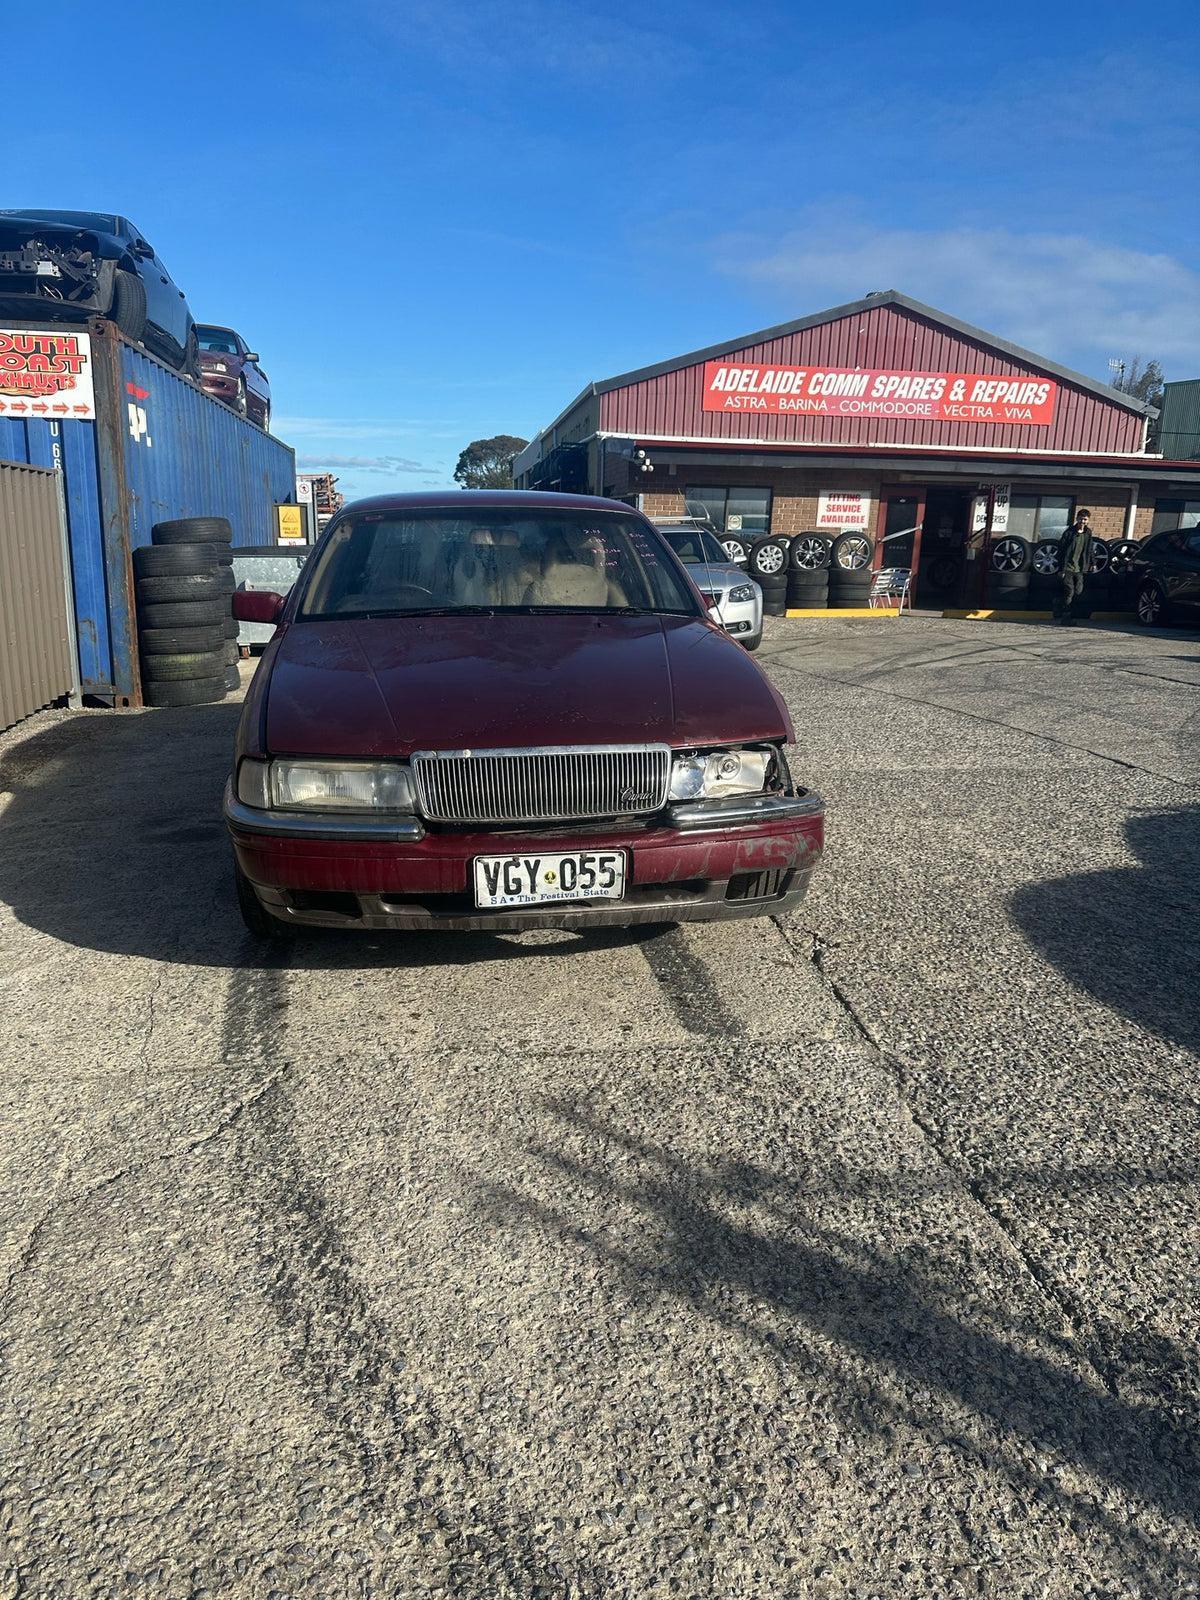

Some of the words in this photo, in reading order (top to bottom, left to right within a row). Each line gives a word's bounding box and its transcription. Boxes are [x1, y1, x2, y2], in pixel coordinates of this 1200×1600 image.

[710, 368, 806, 394] ADELAIDE
[808, 373, 870, 397] COMM
[871, 375, 947, 400] SPARES
[949, 379, 967, 402] &
[970, 380, 1050, 406] REPAIRS
[724, 396, 767, 409] ASTRA
[779, 398, 828, 411] BARINA
[839, 400, 932, 415] COMMODORE
[943, 405, 994, 418] VECTRA
[1004, 407, 1032, 420] VIVA
[829, 493, 861, 502] FITTING
[826, 504, 861, 513] SERVICE
[821, 515, 865, 524] AVAILABLE
[482, 859, 541, 896] VGY
[559, 856, 616, 892] 055
[517, 894, 536, 903] The
[540, 890, 579, 900] Festival
[583, 887, 610, 897] State
